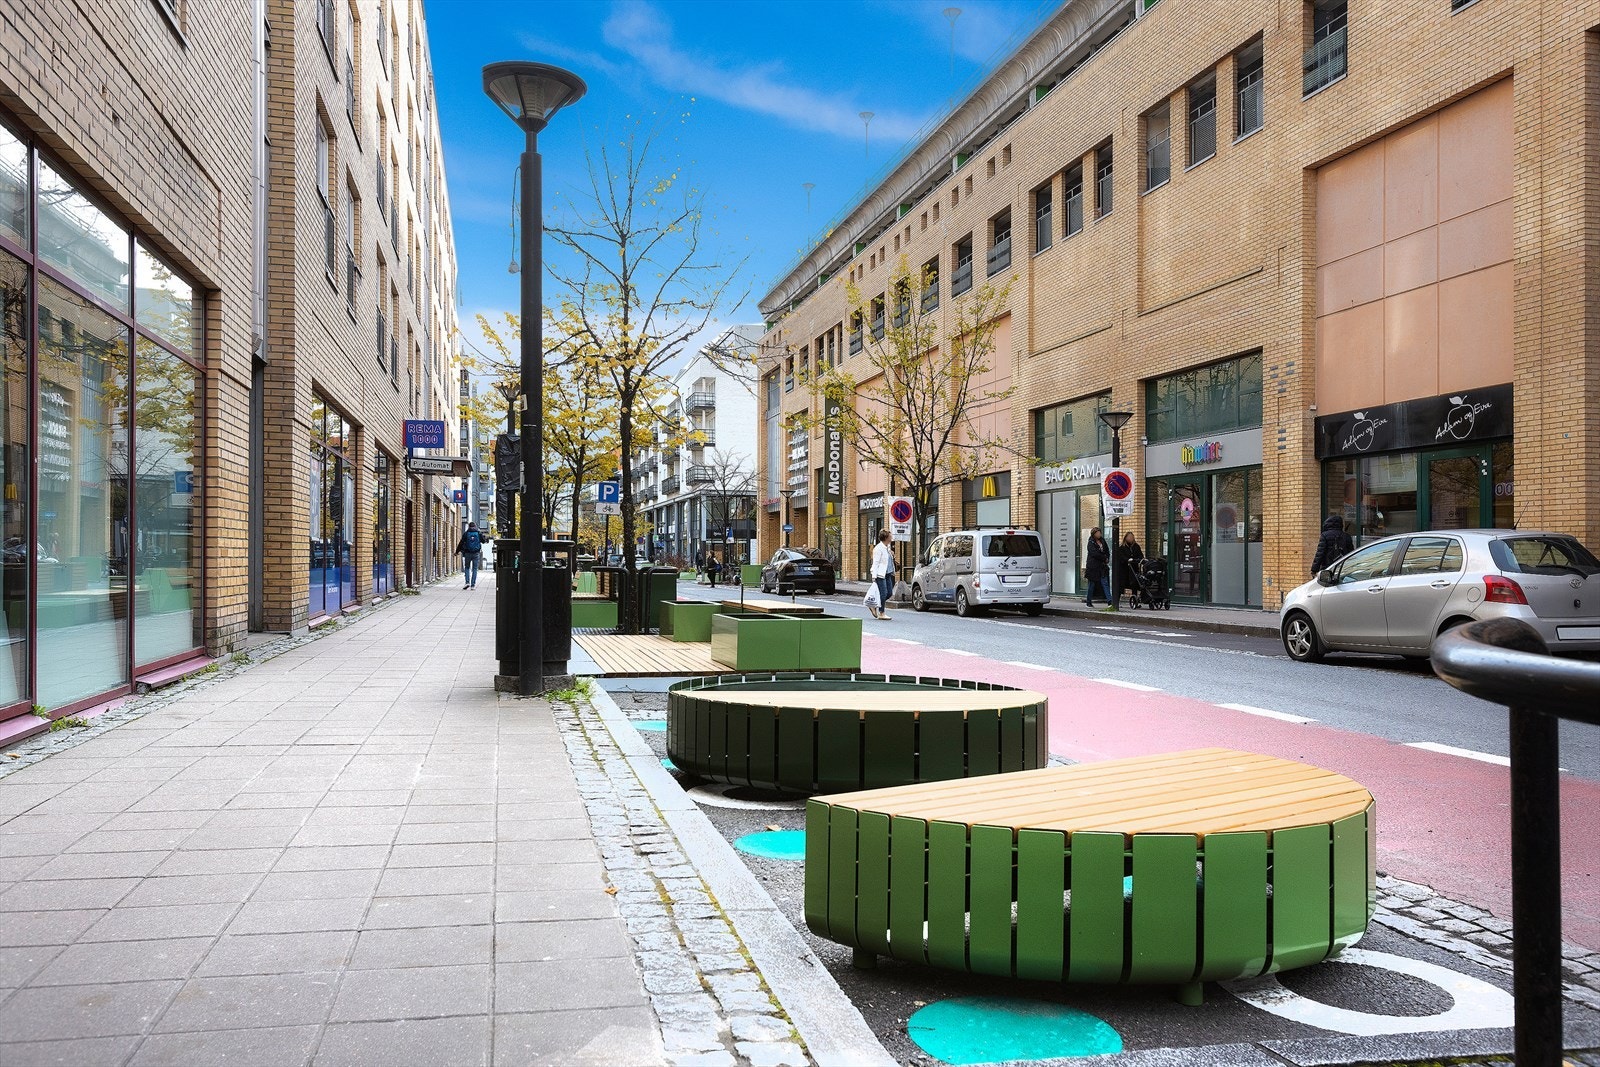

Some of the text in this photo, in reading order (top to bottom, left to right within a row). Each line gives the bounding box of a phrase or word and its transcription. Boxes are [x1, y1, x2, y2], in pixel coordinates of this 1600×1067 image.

[407, 423, 442, 434] REMA
[1434, 402, 1493, 440] Adam og Eva
[412, 434, 438, 445] 1000
[1341, 431, 1365, 451] Adam
[1373, 418, 1388, 429] Eva
[828, 405, 841, 496] McDonas
[1044, 462, 1102, 484] BAGORAMA
[603, 484, 615, 500] P
